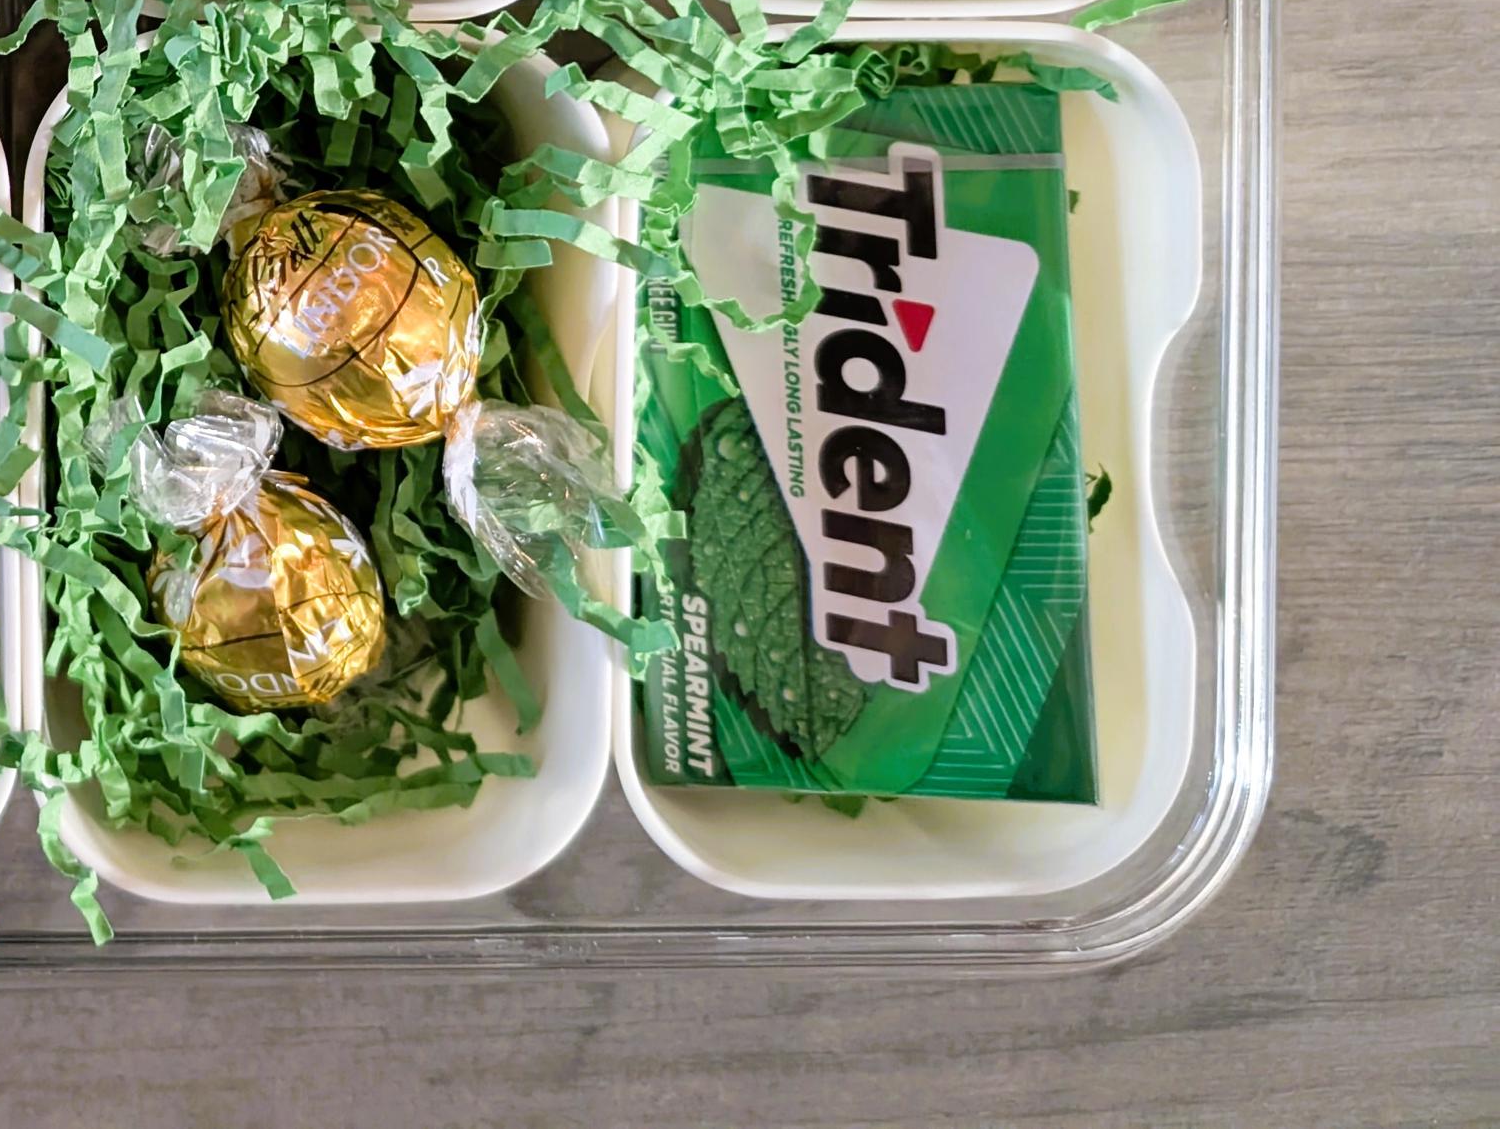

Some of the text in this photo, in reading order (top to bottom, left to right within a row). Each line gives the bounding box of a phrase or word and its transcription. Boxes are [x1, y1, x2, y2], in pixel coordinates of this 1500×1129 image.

[280, 226, 398, 359] LINDOR
[647, 279, 675, 306] REE
[778, 219, 804, 497] REFRESHGLY LONG LASTING
[806, 154, 950, 685] Trident
[662, 692, 679, 771] FLAVOR
[681, 592, 712, 776] SPEARMINT
